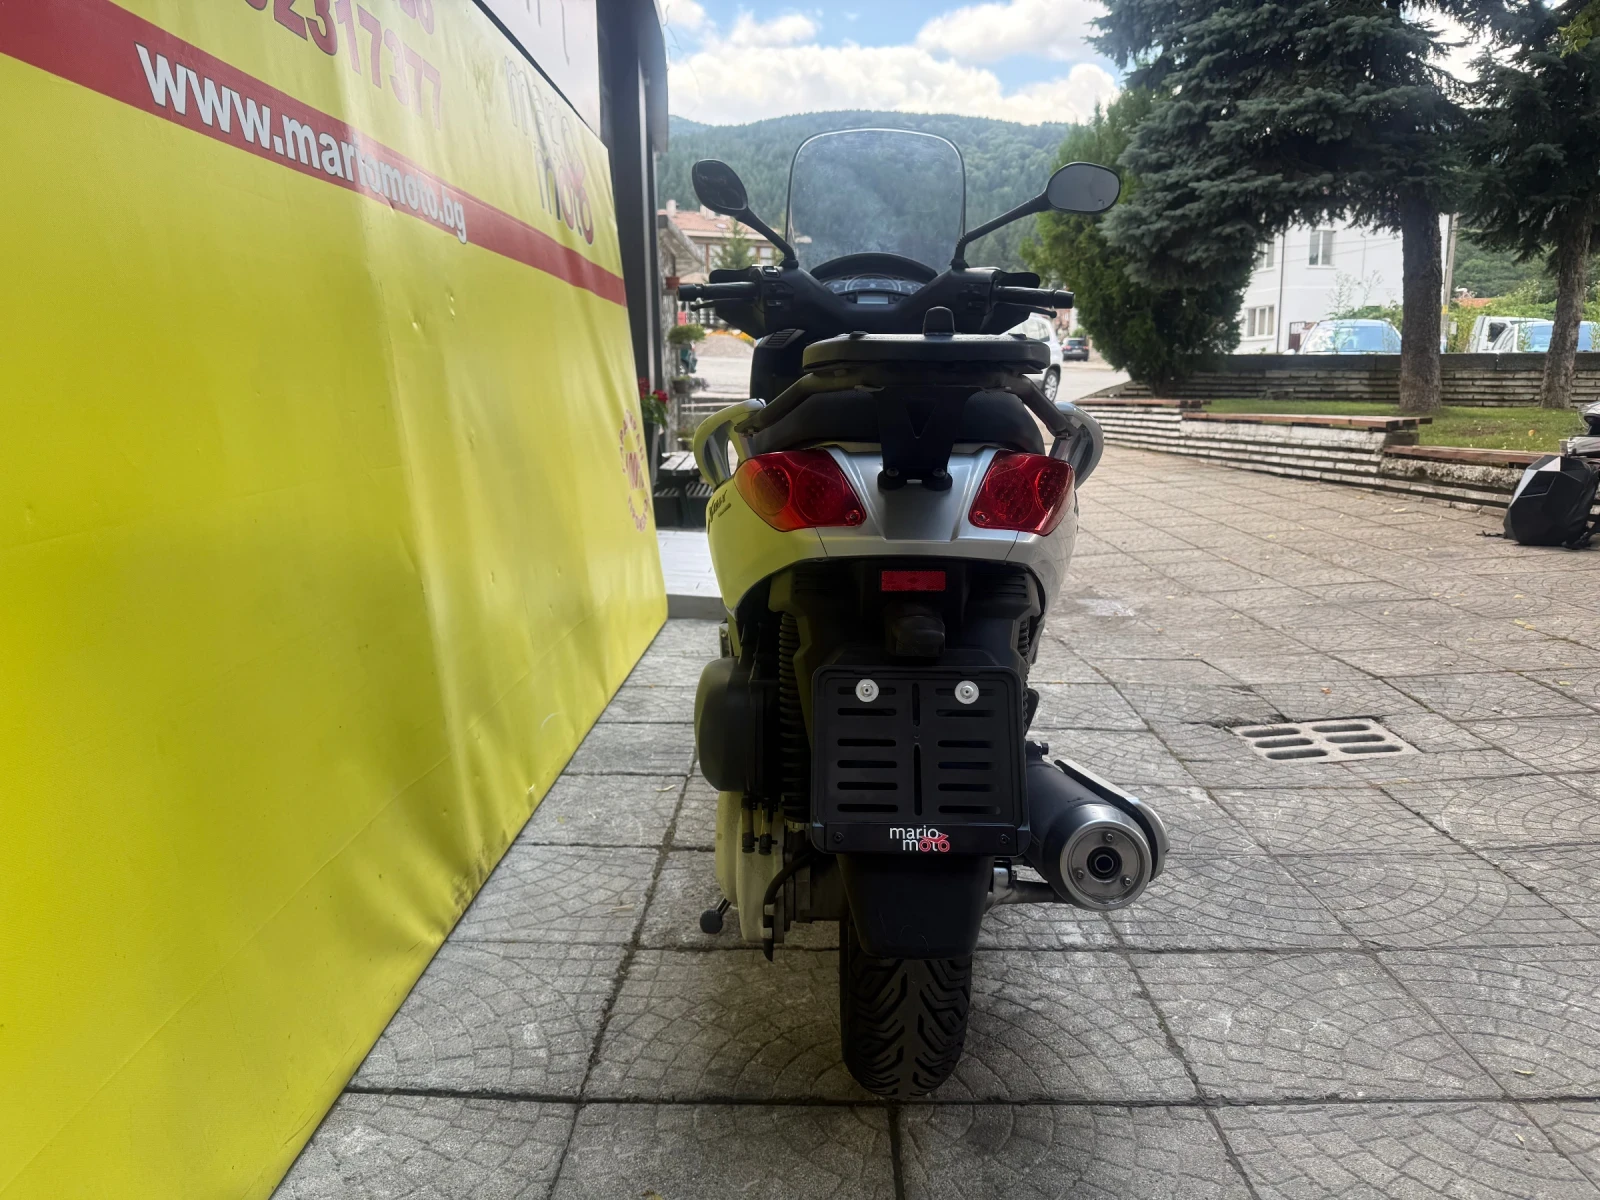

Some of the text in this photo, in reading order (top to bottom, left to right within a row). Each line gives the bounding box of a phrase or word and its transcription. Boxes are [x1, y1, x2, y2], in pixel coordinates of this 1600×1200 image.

[243, 0, 441, 130] 317377
[135, 43, 467, 244] www.mariomoto.bg
[889, 824, 939, 840] mario
[902, 838, 950, 853] moto
